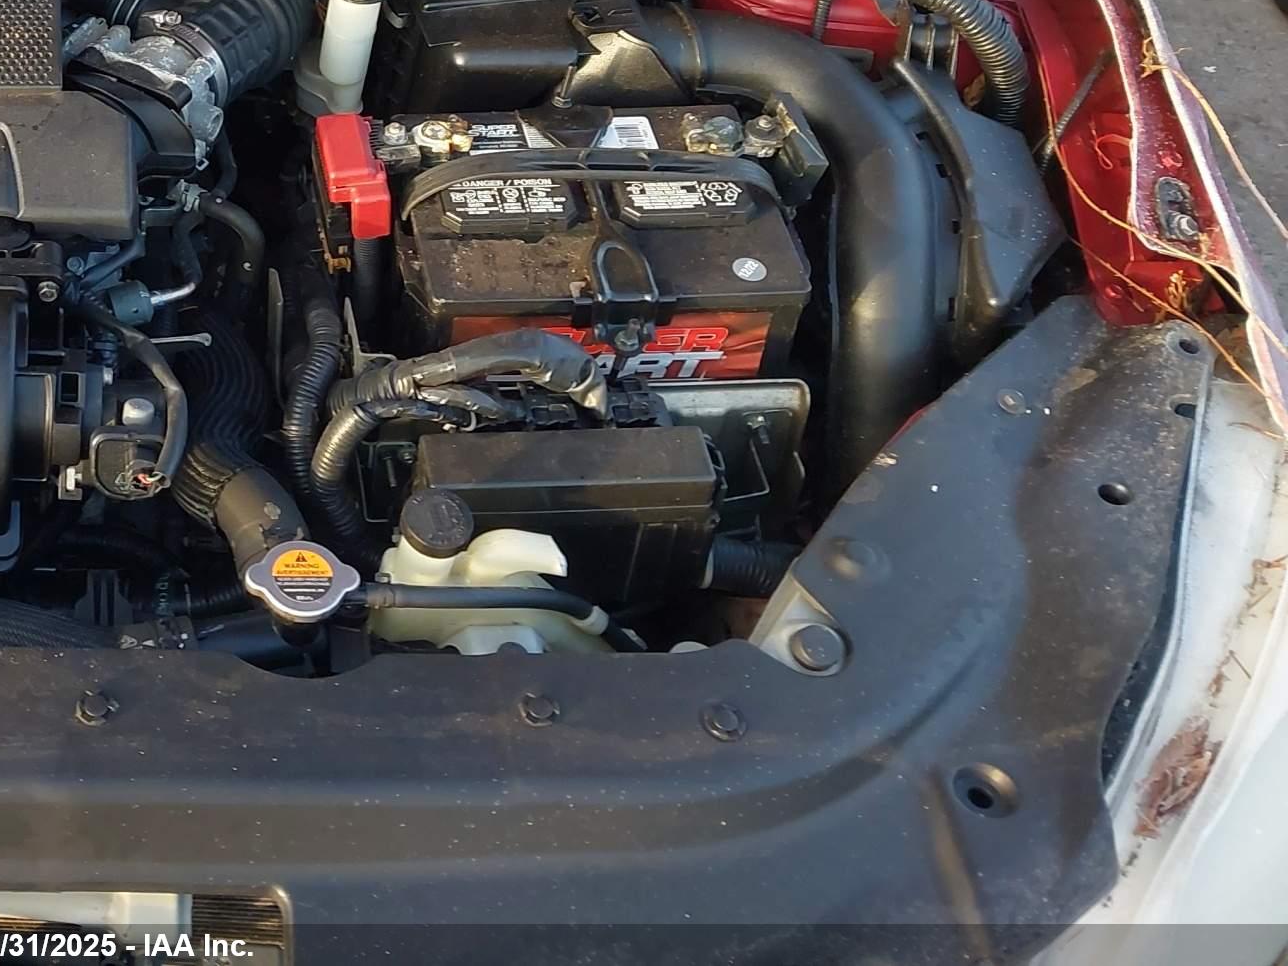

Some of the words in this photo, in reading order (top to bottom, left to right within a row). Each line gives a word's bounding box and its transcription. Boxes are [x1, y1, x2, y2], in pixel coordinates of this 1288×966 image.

[471, 123, 517, 131] SUPER
[468, 129, 521, 138] START
[462, 179, 505, 187] DANGER
[513, 177, 553, 186] POISON
